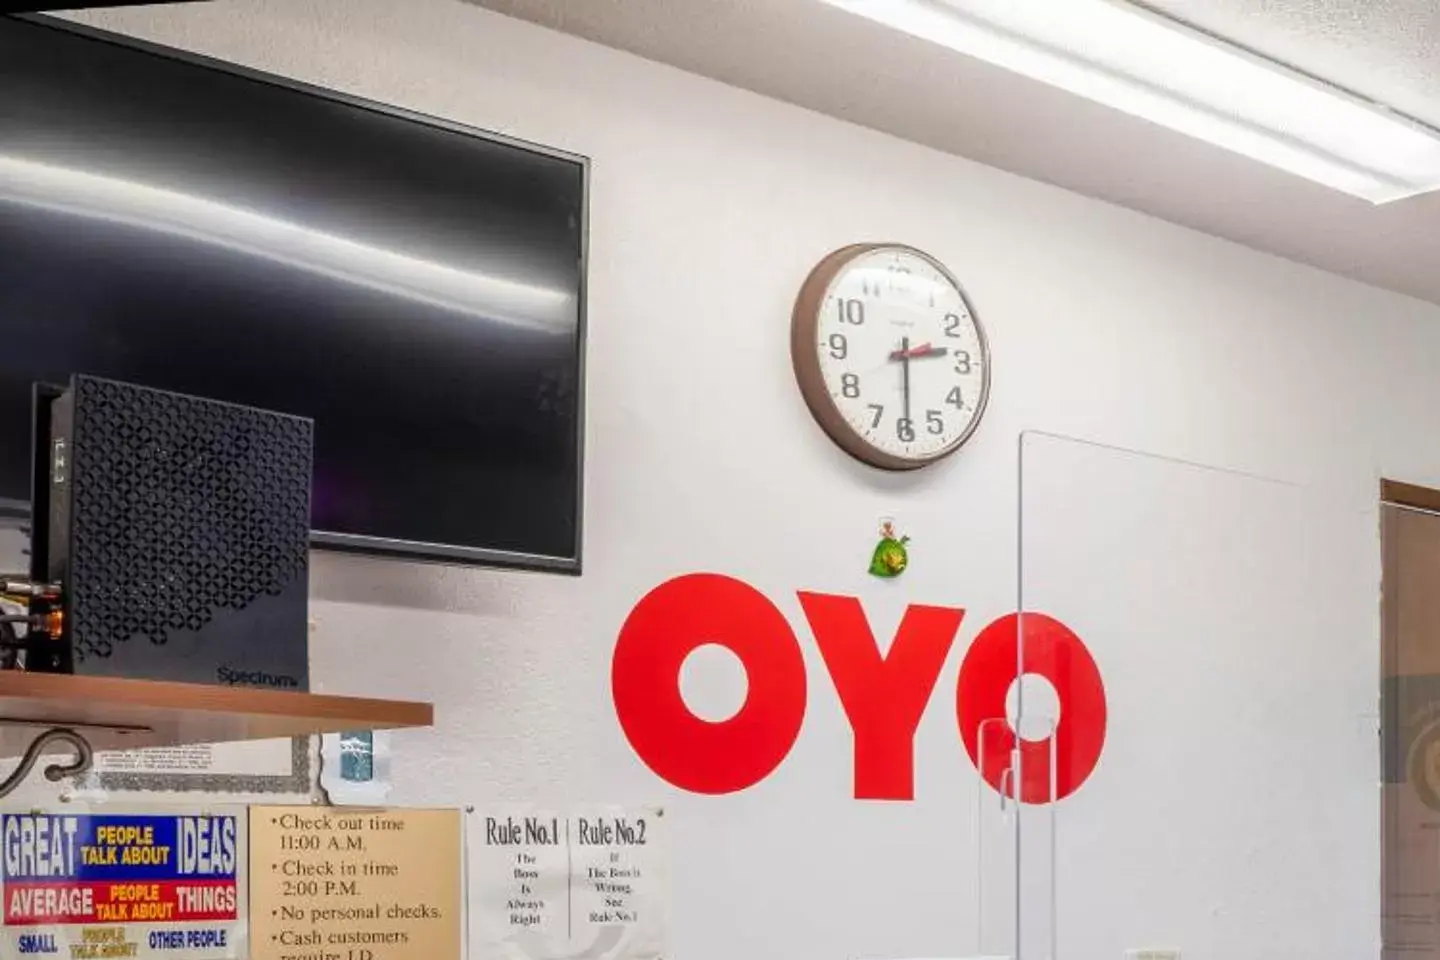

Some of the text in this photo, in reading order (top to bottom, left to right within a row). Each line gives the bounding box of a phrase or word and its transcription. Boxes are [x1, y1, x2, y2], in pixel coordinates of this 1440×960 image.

[837, 297, 864, 325] 10
[944, 313, 960, 338] 2
[829, 333, 847, 360] 9
[953, 350, 971, 375] 3
[841, 373, 860, 399] 8
[945, 386, 964, 410] 4
[867, 403, 884, 429] 7
[925, 410, 944, 435] 5
[896, 417, 915, 443] 6
[216, 666, 297, 687] Spectrum
[611, 572, 1107, 805] OYO
[279, 813, 405, 831] Check out time
[486, 816, 559, 846] Rule No.1
[578, 817, 647, 846] Rule No.2
[5, 816, 77, 877] GREAT
[97, 826, 154, 844] PEOPLE
[177, 816, 235, 875] IDEAS
[280, 834, 367, 852] 11:00 A.M.
[80, 846, 170, 865] TALK ABOUT
[281, 860, 399, 876] Check in time
[110, 884, 160, 901] PEOPLE
[176, 886, 236, 913] THINGS
[283, 880, 360, 897] 2:00 P.M.
[10, 888, 93, 917] AVERAGE
[96, 902, 174, 920] TALK ABOUT
[280, 903, 443, 923] No personal checks.
[506, 898, 545, 913] Always
[509, 913, 541, 926] Right
[19, 934, 58, 953] SMALL
[149, 929, 227, 949] OTHER PEOPLE
[279, 929, 409, 946] Cash customers
